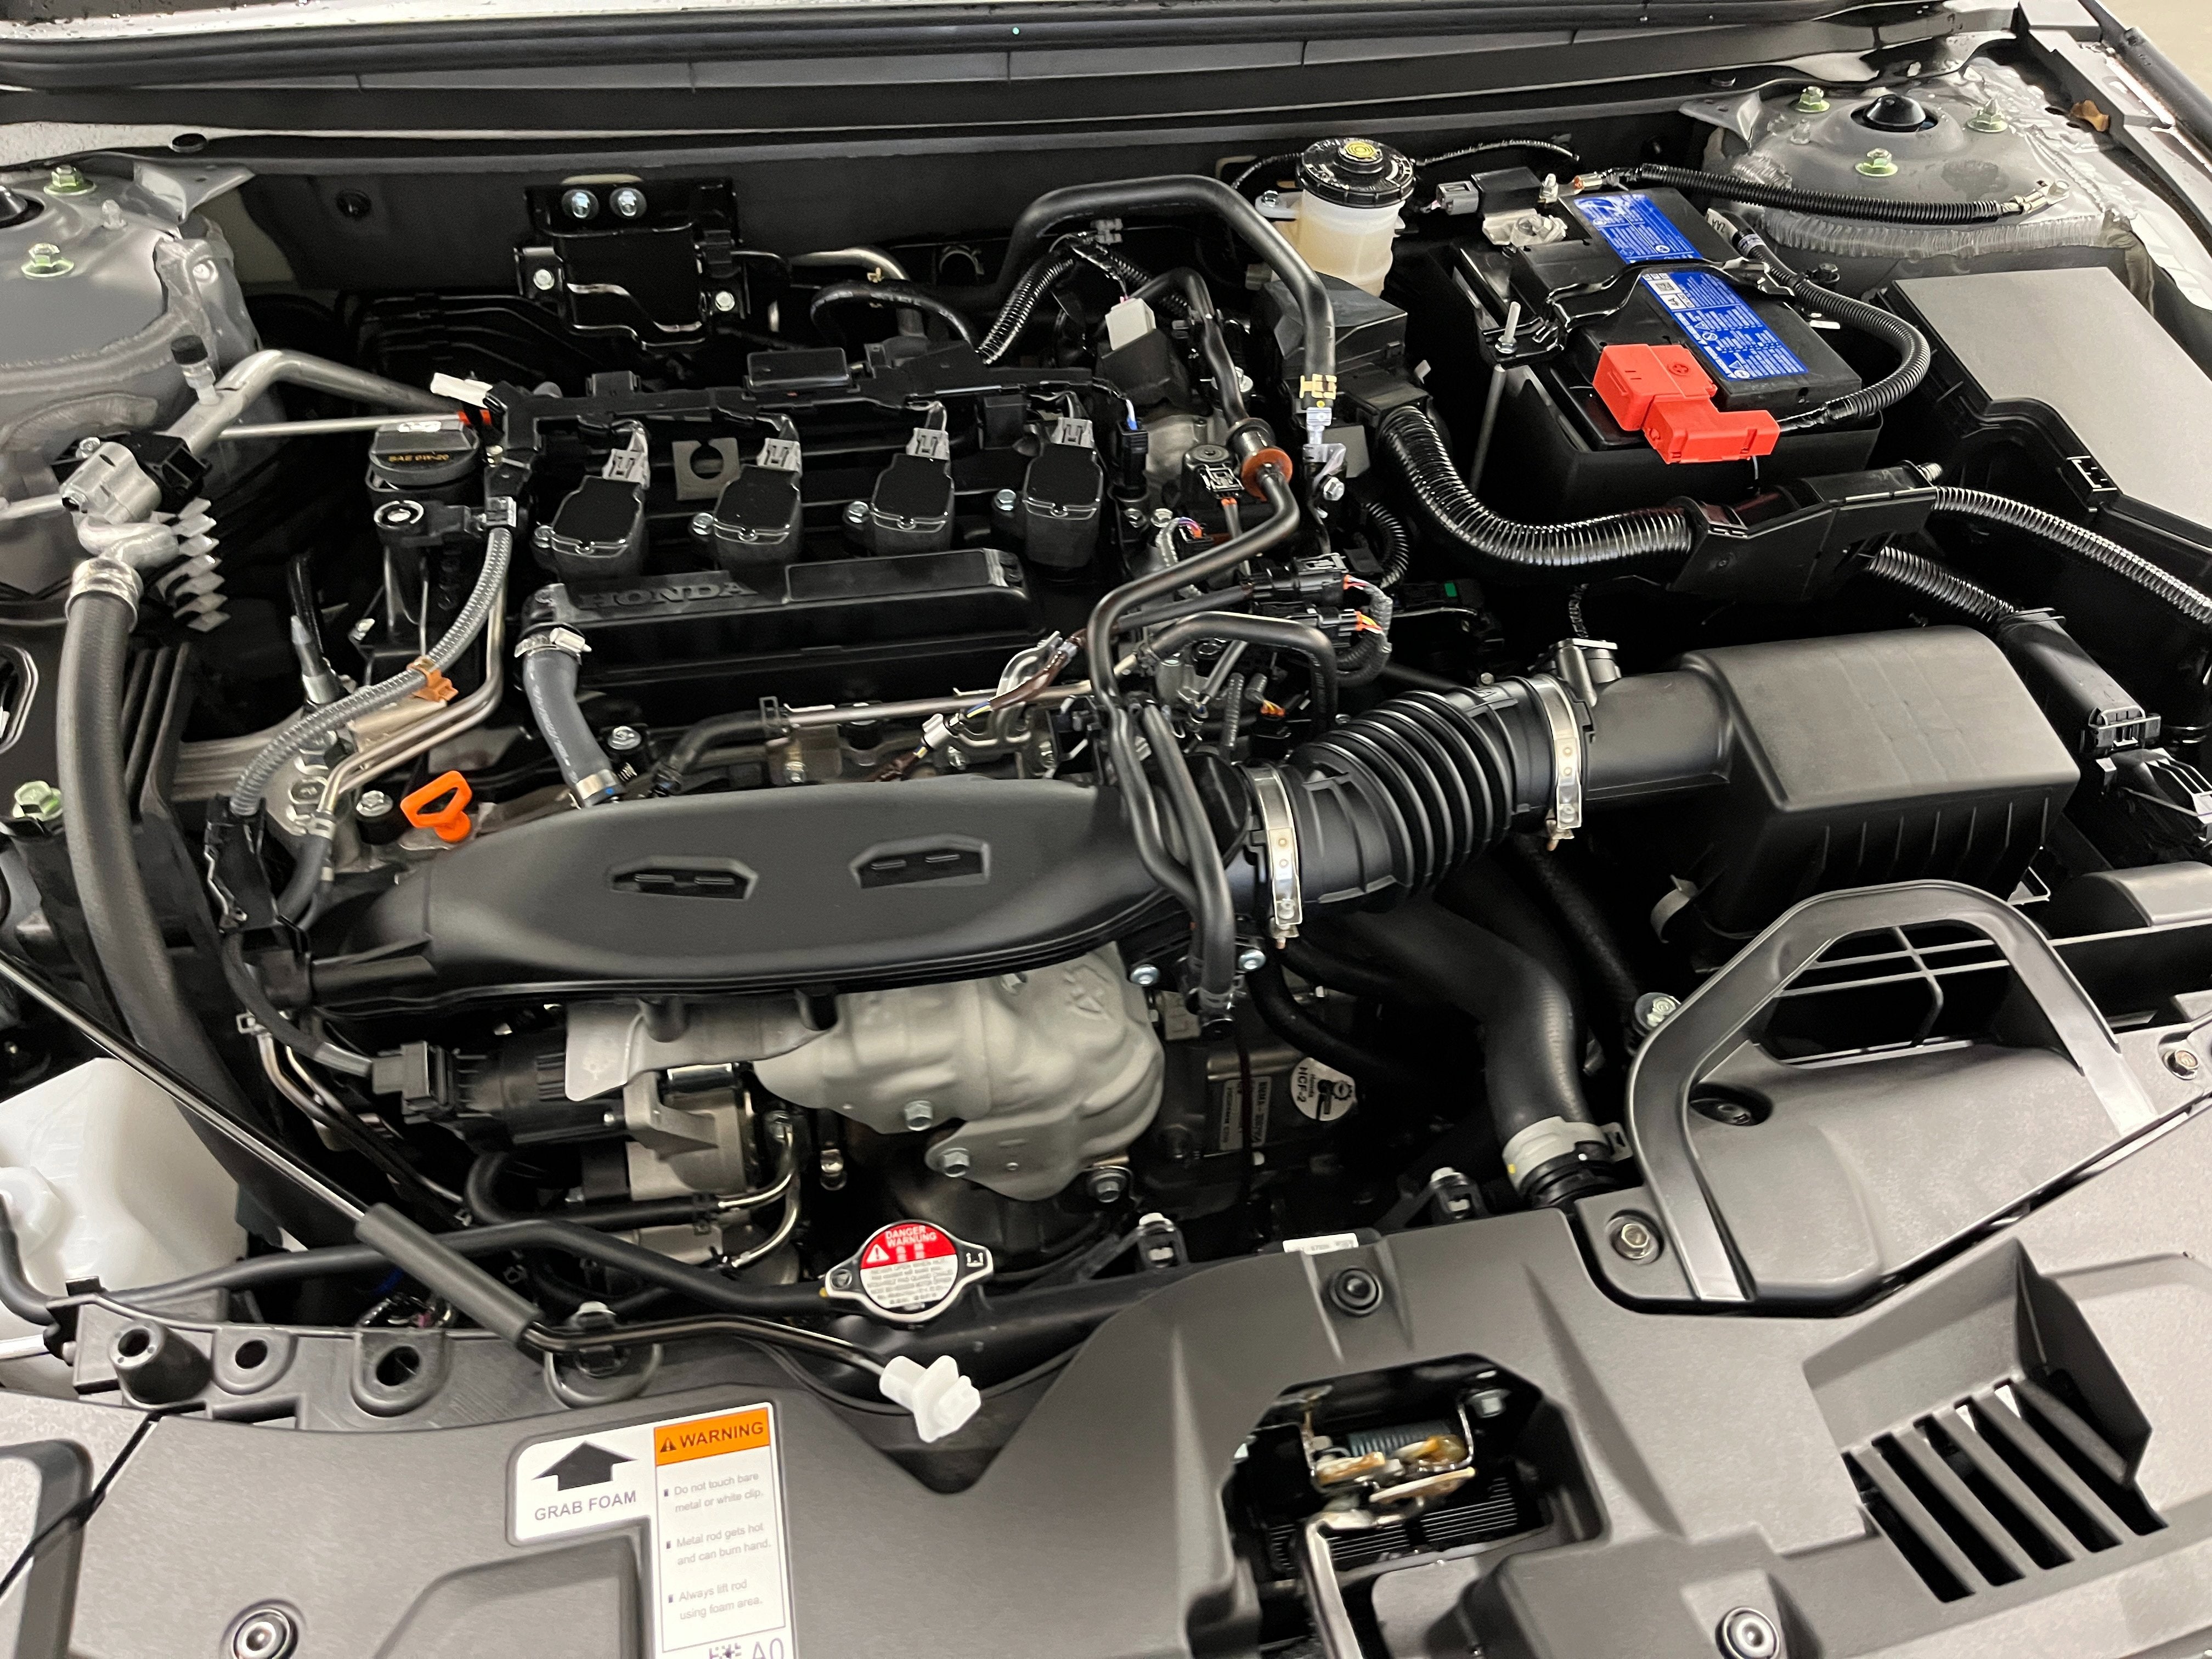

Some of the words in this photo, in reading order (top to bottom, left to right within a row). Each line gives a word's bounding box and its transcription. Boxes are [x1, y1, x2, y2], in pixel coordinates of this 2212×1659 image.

[579, 582, 758, 610] HONDA
[1296, 1066, 1308, 1103] HCF-2
[885, 1225, 926, 1240] DANGER
[887, 1232, 938, 1248] WARNUNG
[680, 1421, 764, 1449] WARNING
[674, 1486, 688, 1495] Do
[691, 1482, 706, 1492] not
[709, 1477, 735, 1488] touch
[737, 1473, 759, 1483] bare
[534, 1500, 583, 1521] GRAB
[589, 1491, 637, 1511] FOAM
[675, 1499, 701, 1513] metal
[704, 1498, 714, 1506] or
[716, 1493, 742, 1504] white
[744, 1489, 764, 1499] clip.
[677, 1533, 703, 1547] Metal
[706, 1530, 722, 1541] rod
[725, 1527, 745, 1539] gets
[748, 1523, 764, 1533] hot
[677, 1554, 696, 1565] and
[698, 1551, 716, 1561] can
[719, 1546, 742, 1556] burn
[744, 1539, 771, 1552] hand.
[679, 1588, 714, 1602] Always
[717, 1583, 729, 1594] lift
[731, 1578, 747, 1590] rod
[680, 1608, 707, 1620] using
[709, 1602, 735, 1614] foam
[737, 1597, 764, 1608] area.
